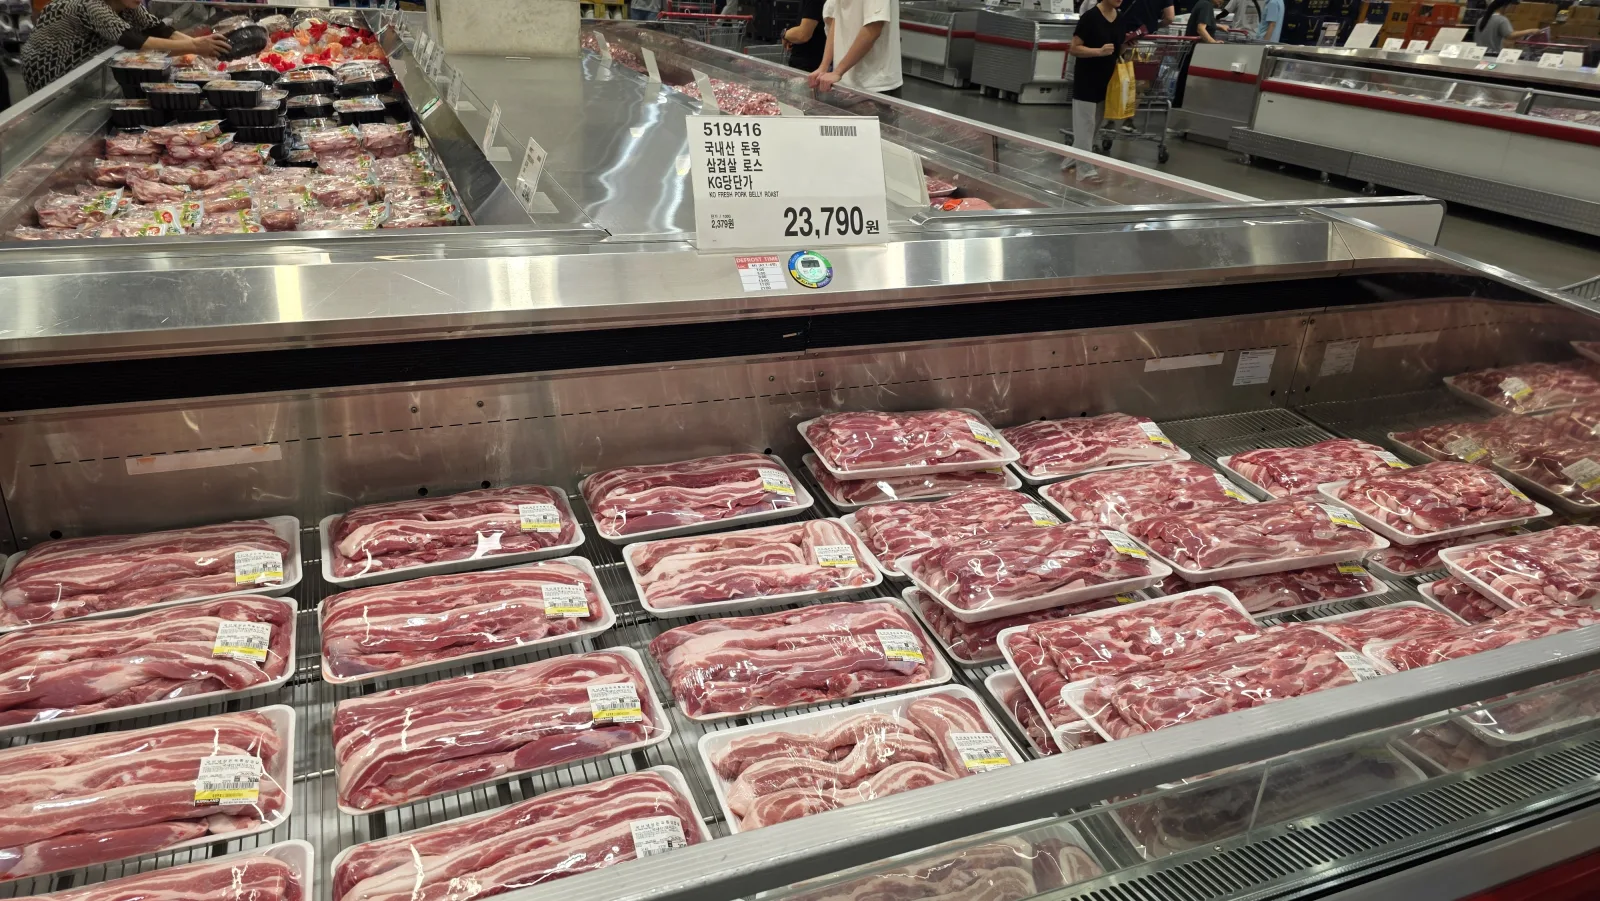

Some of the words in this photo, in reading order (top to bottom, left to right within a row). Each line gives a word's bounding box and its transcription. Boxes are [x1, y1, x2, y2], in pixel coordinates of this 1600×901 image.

[703, 122, 762, 137] 519416
[704, 141, 735, 157] 국내산
[741, 141, 761, 157] 돈육
[706, 158, 737, 173] 삼겹살
[743, 158, 763, 172] 로스
[707, 175, 753, 190] KG당단가
[711, 218, 735, 229] 2,379원
[735, 256, 762, 264] DEFROST
[764, 255, 778, 263] TIME
